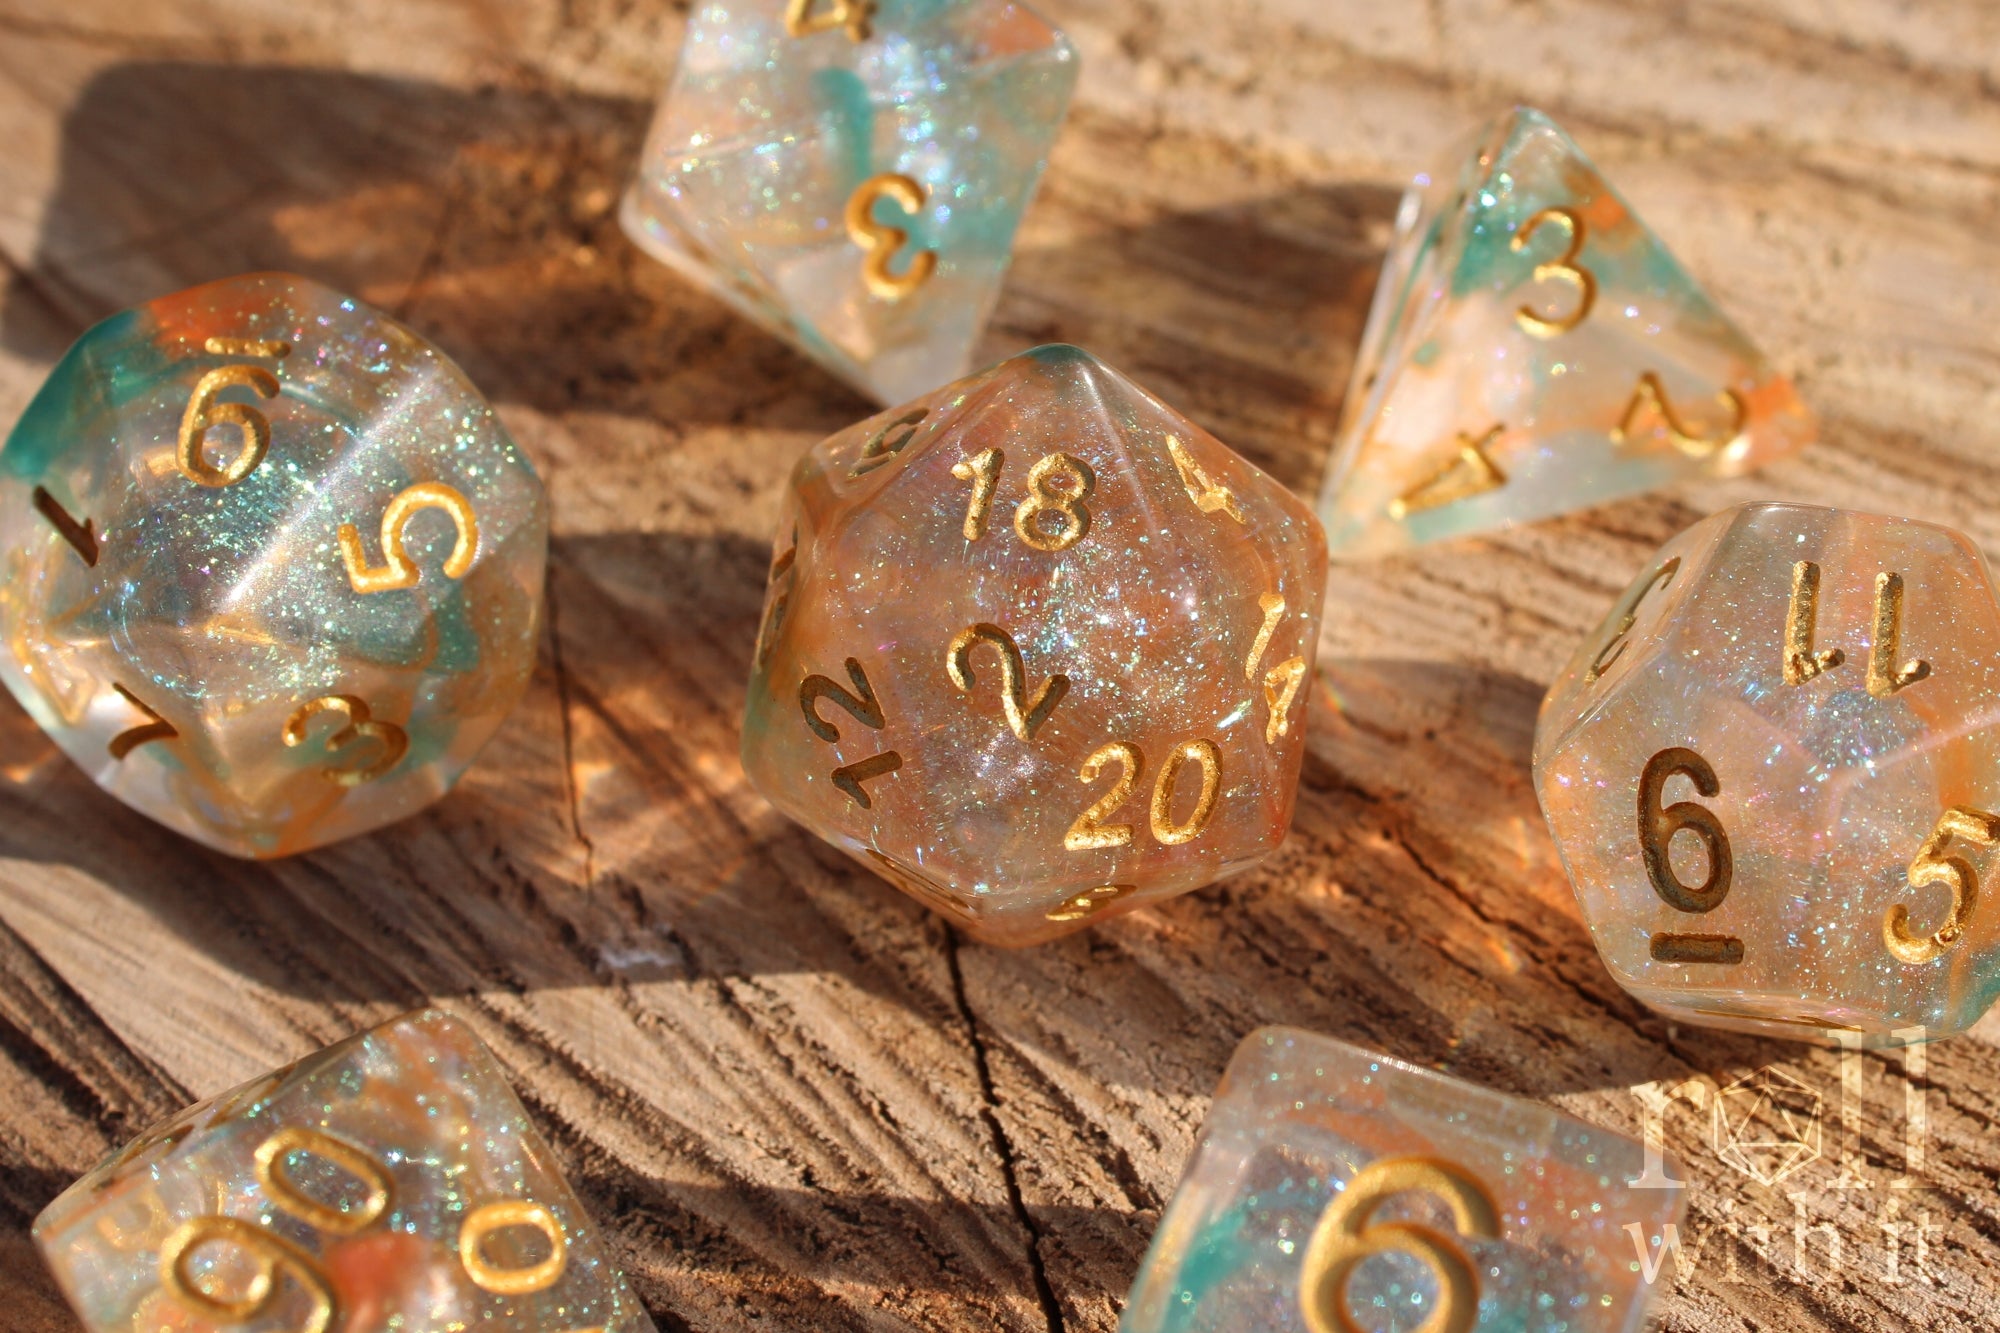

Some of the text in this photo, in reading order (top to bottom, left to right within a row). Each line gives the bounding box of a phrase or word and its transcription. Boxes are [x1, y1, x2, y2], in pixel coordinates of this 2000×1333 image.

[845, 173, 938, 298] 3
[1510, 207, 1597, 339] 3
[1610, 371, 1748, 460] 2
[951, 447, 1097, 552] 18
[1166, 433, 1247, 525] 4
[338, 482, 479, 595] 5
[799, 657, 903, 810] 12
[946, 622, 1071, 742] 2
[281, 694, 408, 786] 3
[1063, 737, 1225, 852] 20
[1883, 804, 2000, 964] 5
